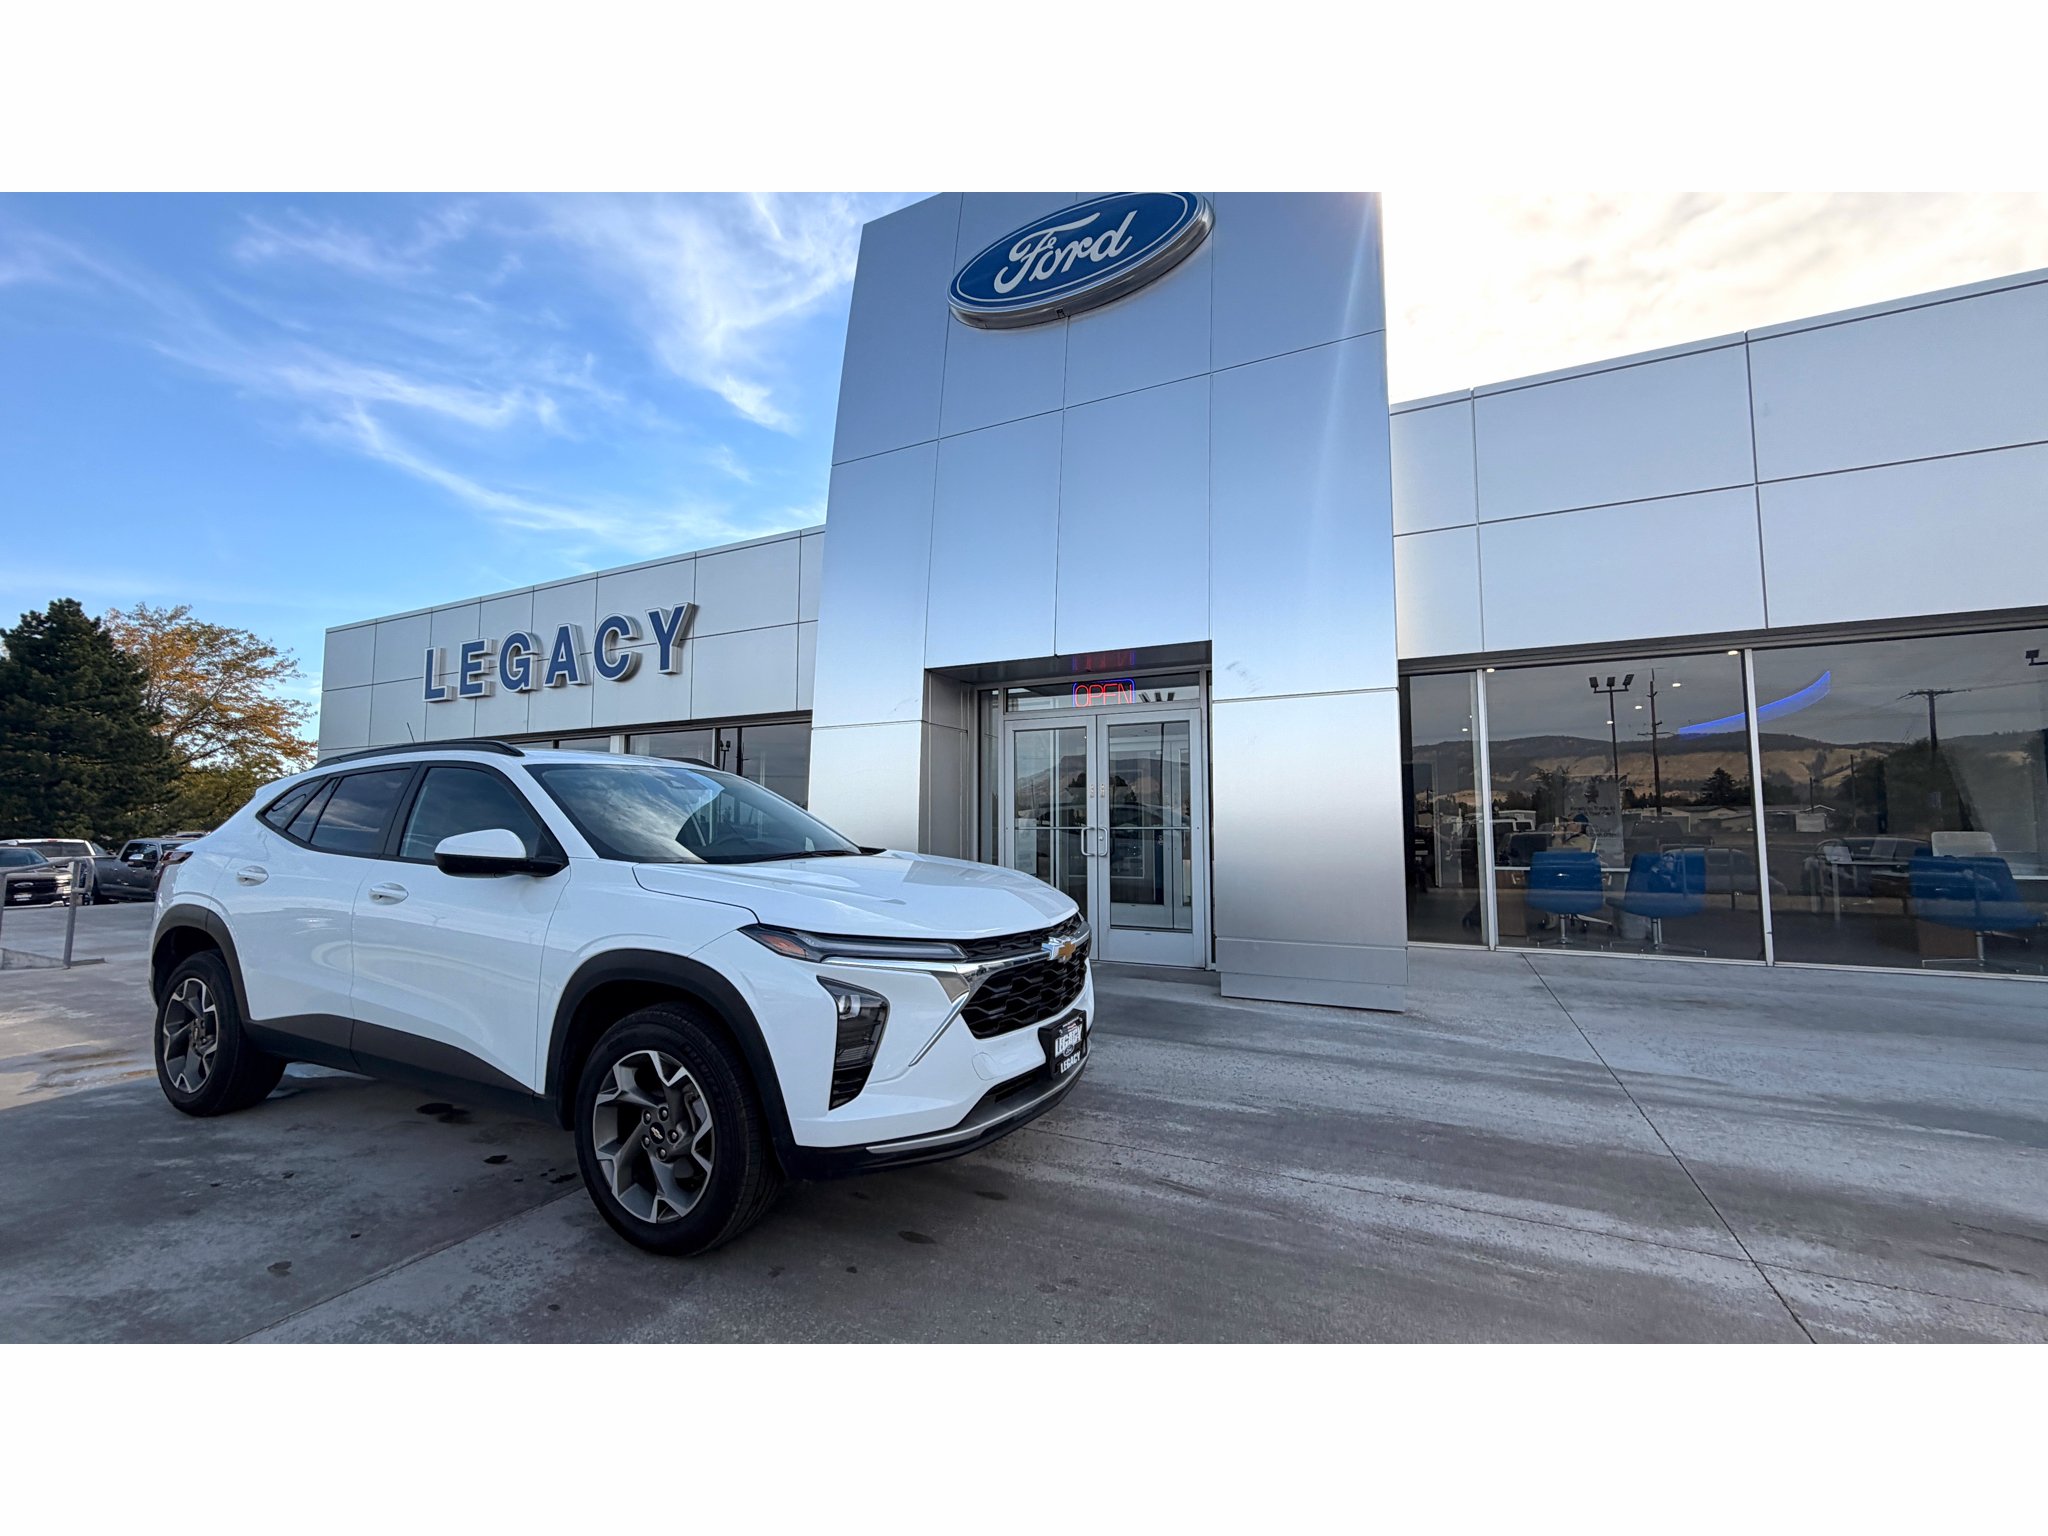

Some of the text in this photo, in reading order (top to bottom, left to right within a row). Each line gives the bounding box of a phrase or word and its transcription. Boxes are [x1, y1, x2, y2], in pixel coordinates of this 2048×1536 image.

[993, 210, 1138, 294] Ford
[423, 602, 694, 702] LEGACY
[1075, 683, 1133, 708] OPEN
[1060, 1050, 1081, 1074] LEGACY
